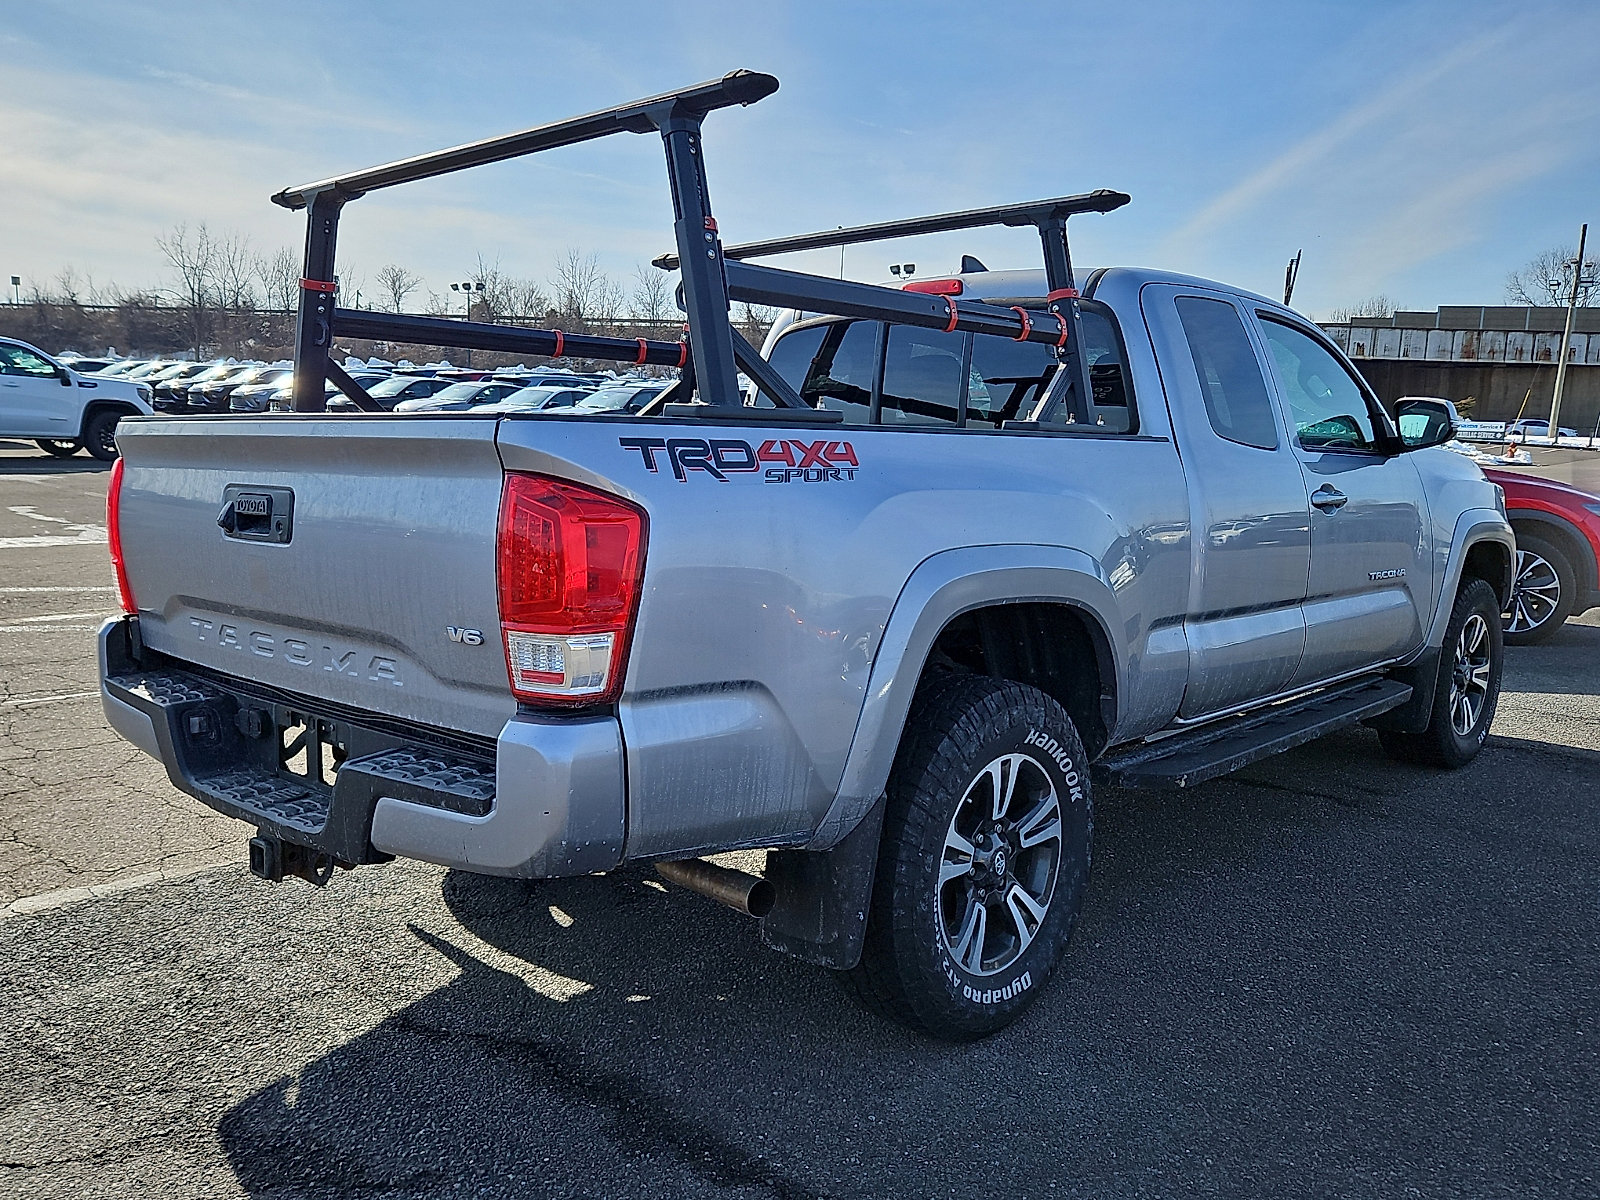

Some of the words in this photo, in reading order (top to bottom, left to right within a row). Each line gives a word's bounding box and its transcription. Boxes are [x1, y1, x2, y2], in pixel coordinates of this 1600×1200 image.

[618, 436, 762, 483] TRD
[764, 467, 860, 484] SPORT
[235, 498, 267, 514] TOYOTA
[1368, 568, 1406, 580] TACOMA
[446, 625, 485, 646] V6
[189, 615, 404, 688] TACOMA
